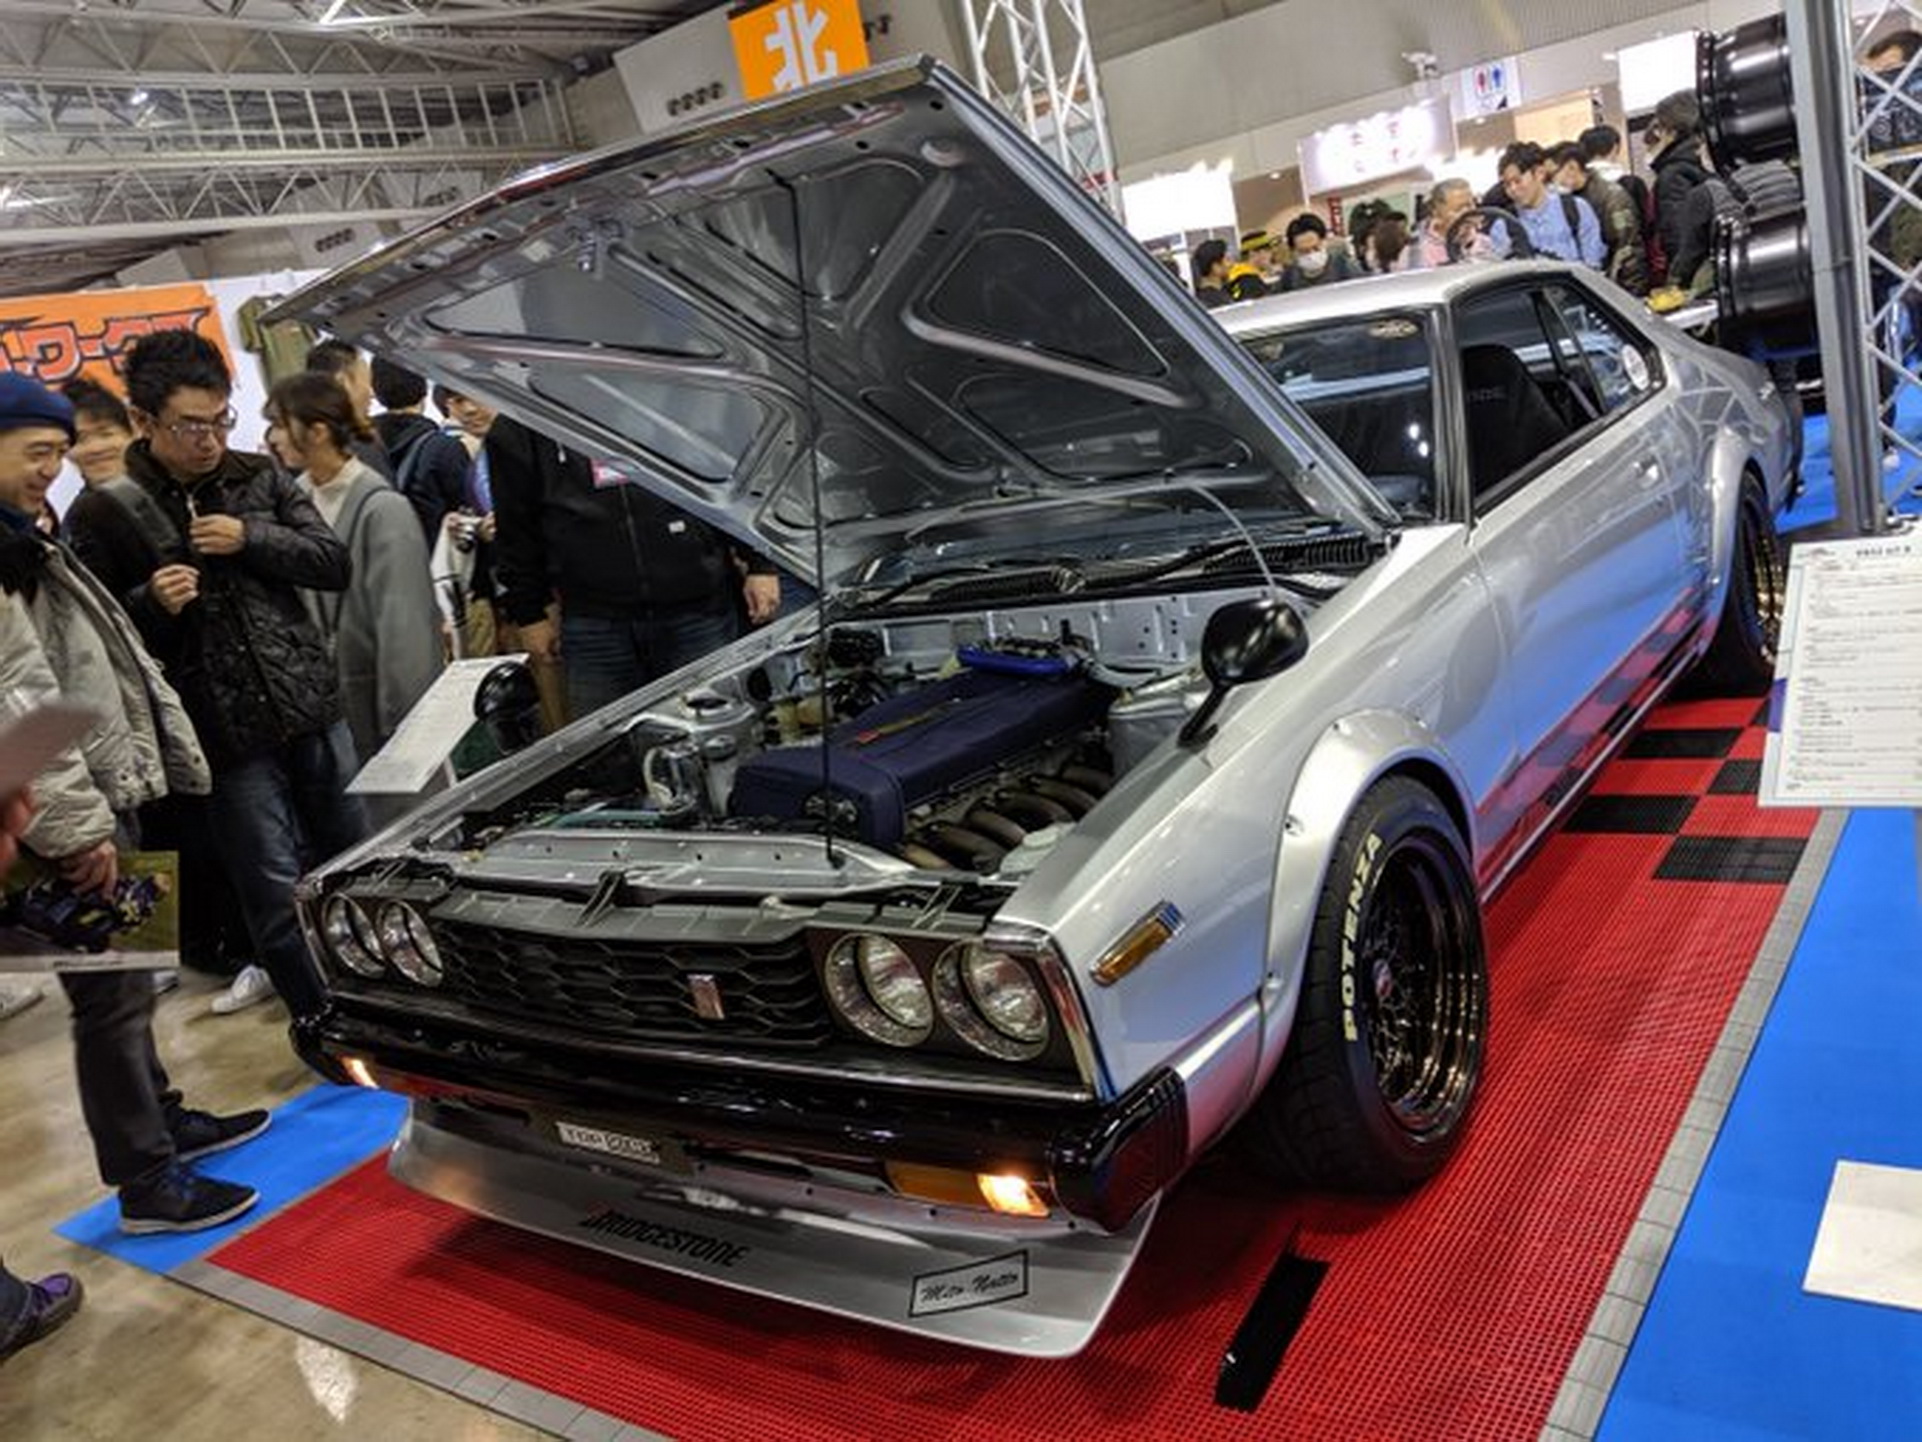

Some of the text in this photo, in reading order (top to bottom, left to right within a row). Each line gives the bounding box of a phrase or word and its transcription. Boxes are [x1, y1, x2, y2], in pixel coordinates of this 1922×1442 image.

[764, 2, 838, 91] 北
[1341, 832, 1383, 1042] POTENZA
[580, 1203, 749, 1267] BRIDGESTONE
